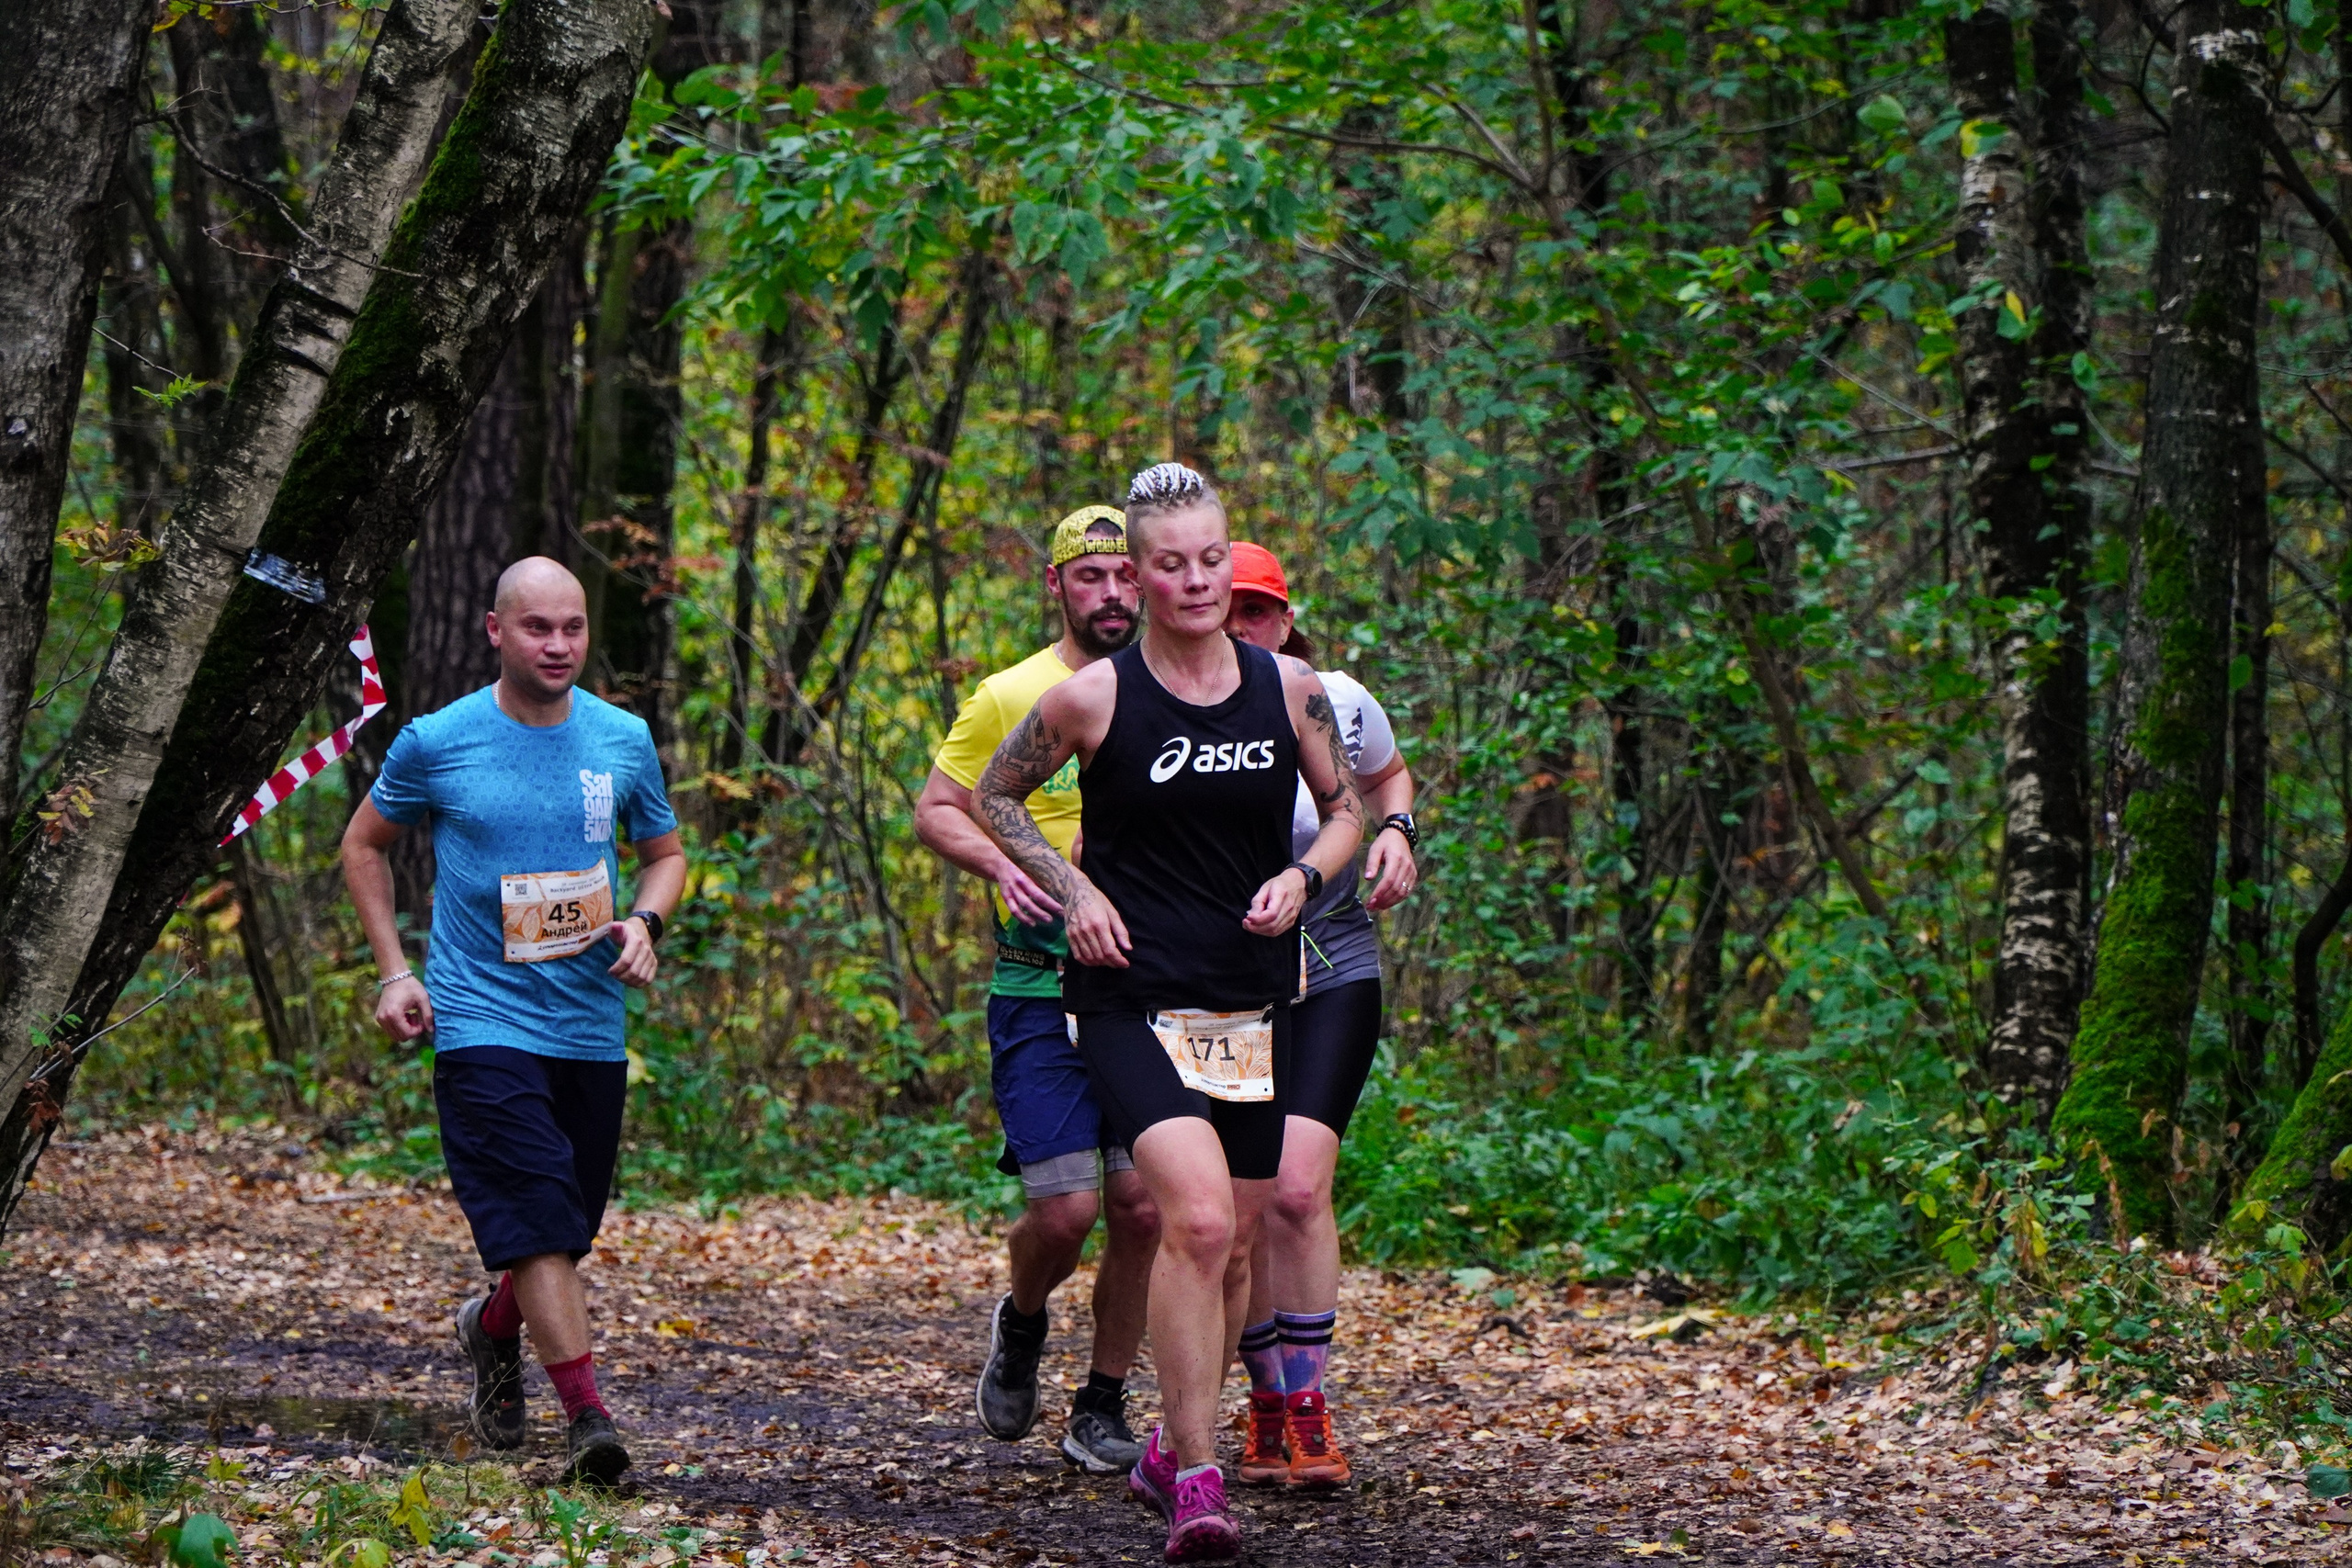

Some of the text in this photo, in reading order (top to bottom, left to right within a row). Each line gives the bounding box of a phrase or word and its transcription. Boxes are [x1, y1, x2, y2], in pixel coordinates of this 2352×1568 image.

[579, 768, 614, 798] Sat
[548, 900, 581, 924] 45
[540, 920, 588, 939] Андрей
[1187, 1036, 1236, 1062] 171
